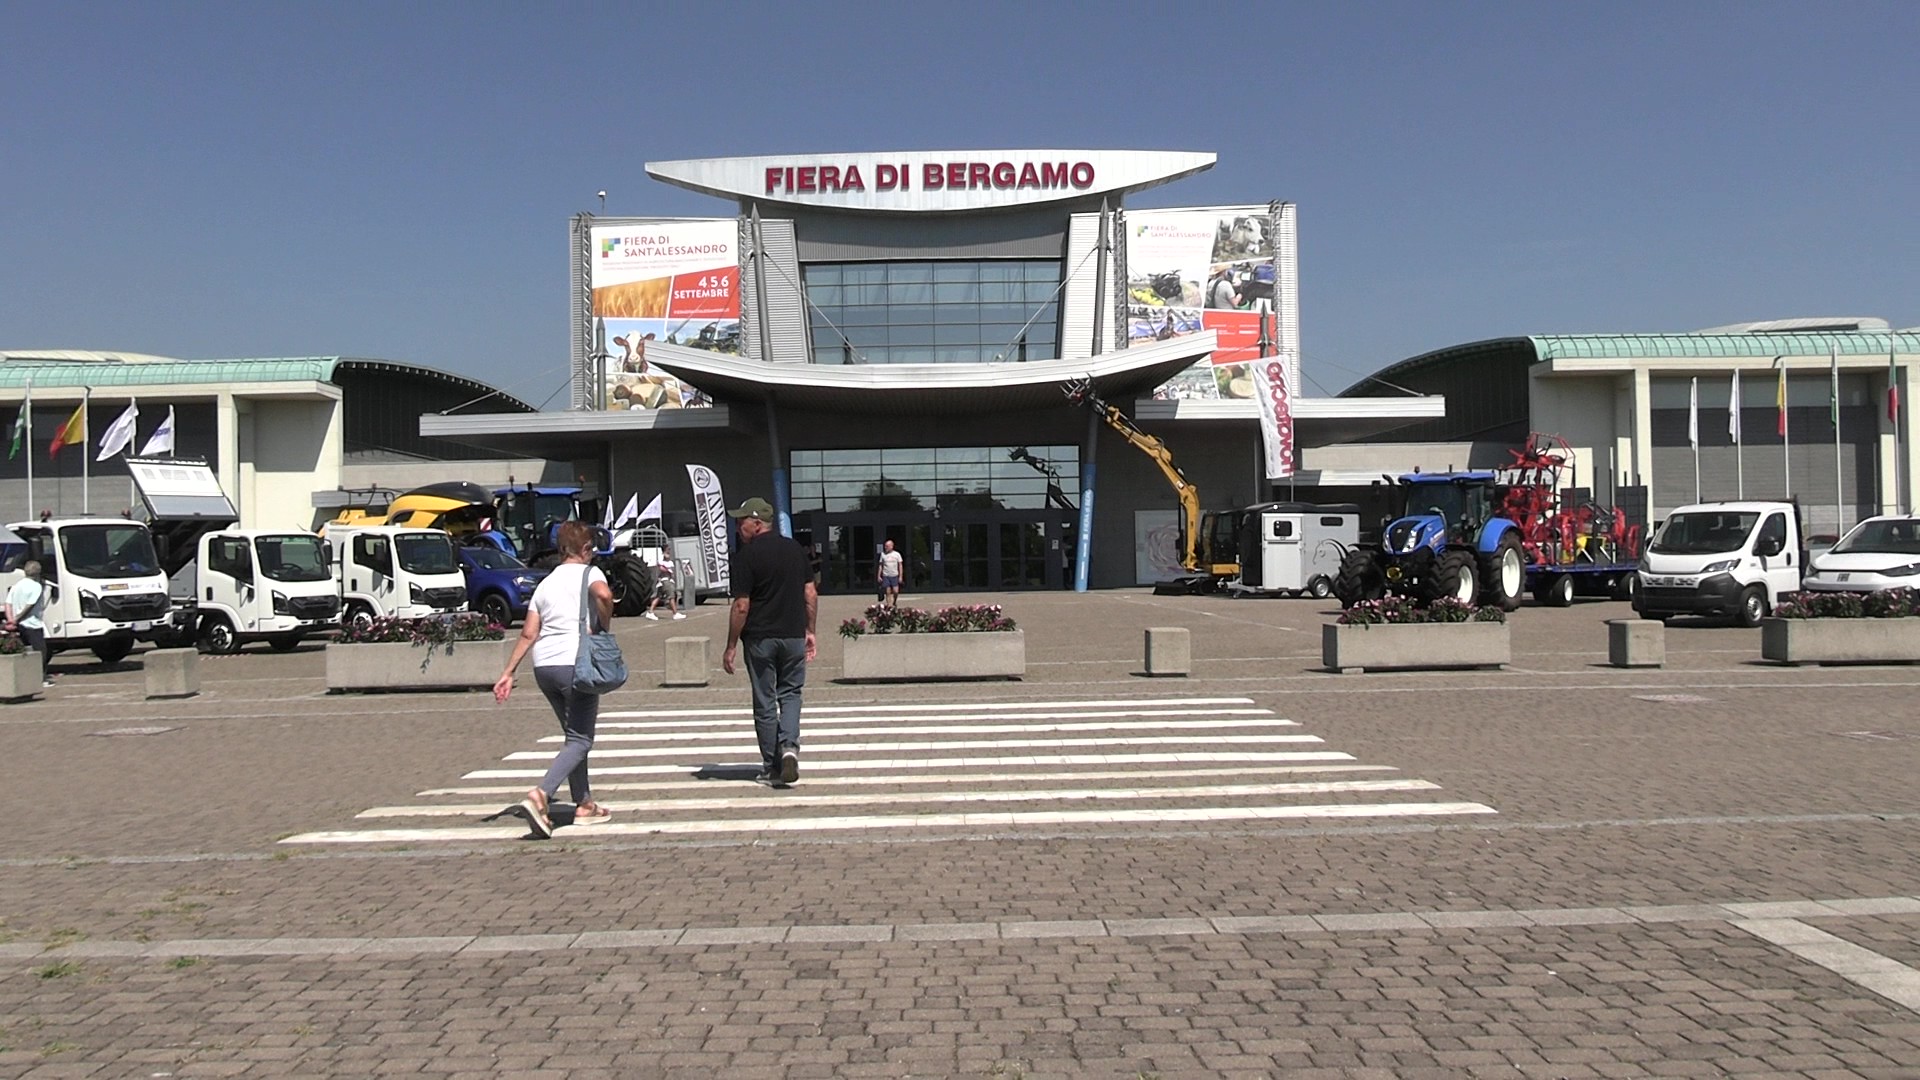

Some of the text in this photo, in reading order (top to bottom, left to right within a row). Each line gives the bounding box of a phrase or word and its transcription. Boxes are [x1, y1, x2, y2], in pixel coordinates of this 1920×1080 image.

[766, 161, 1095, 193] FIERA DI BERGAMO
[624, 235, 670, 246] FIERA DI
[624, 244, 728, 258] SANT'ALESSANDRO
[674, 288, 729, 299] SETTEMBRE
